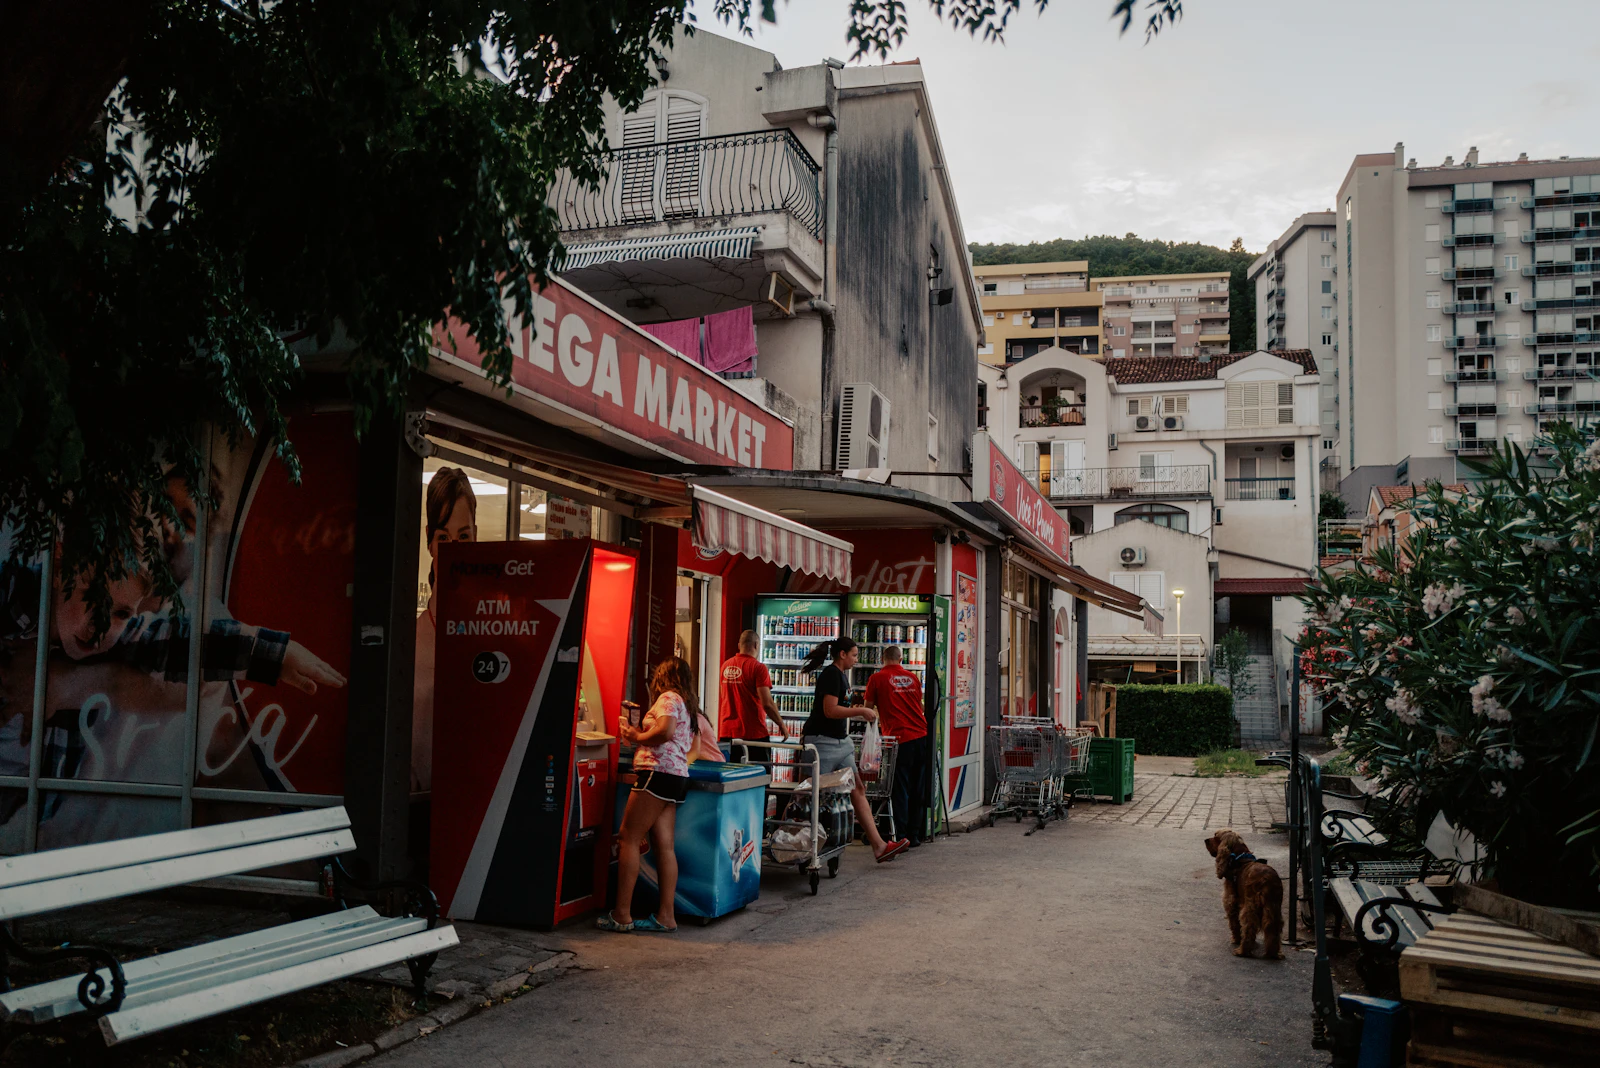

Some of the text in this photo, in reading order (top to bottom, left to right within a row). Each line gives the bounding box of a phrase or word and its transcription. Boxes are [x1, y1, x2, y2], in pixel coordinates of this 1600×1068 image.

[634, 354, 766, 468] MARKET
[475, 599, 511, 615] ATM
[860, 594, 918, 611] TUBORG
[446, 620, 540, 636] BANKOMAT
[477, 660, 509, 674] 24 7
